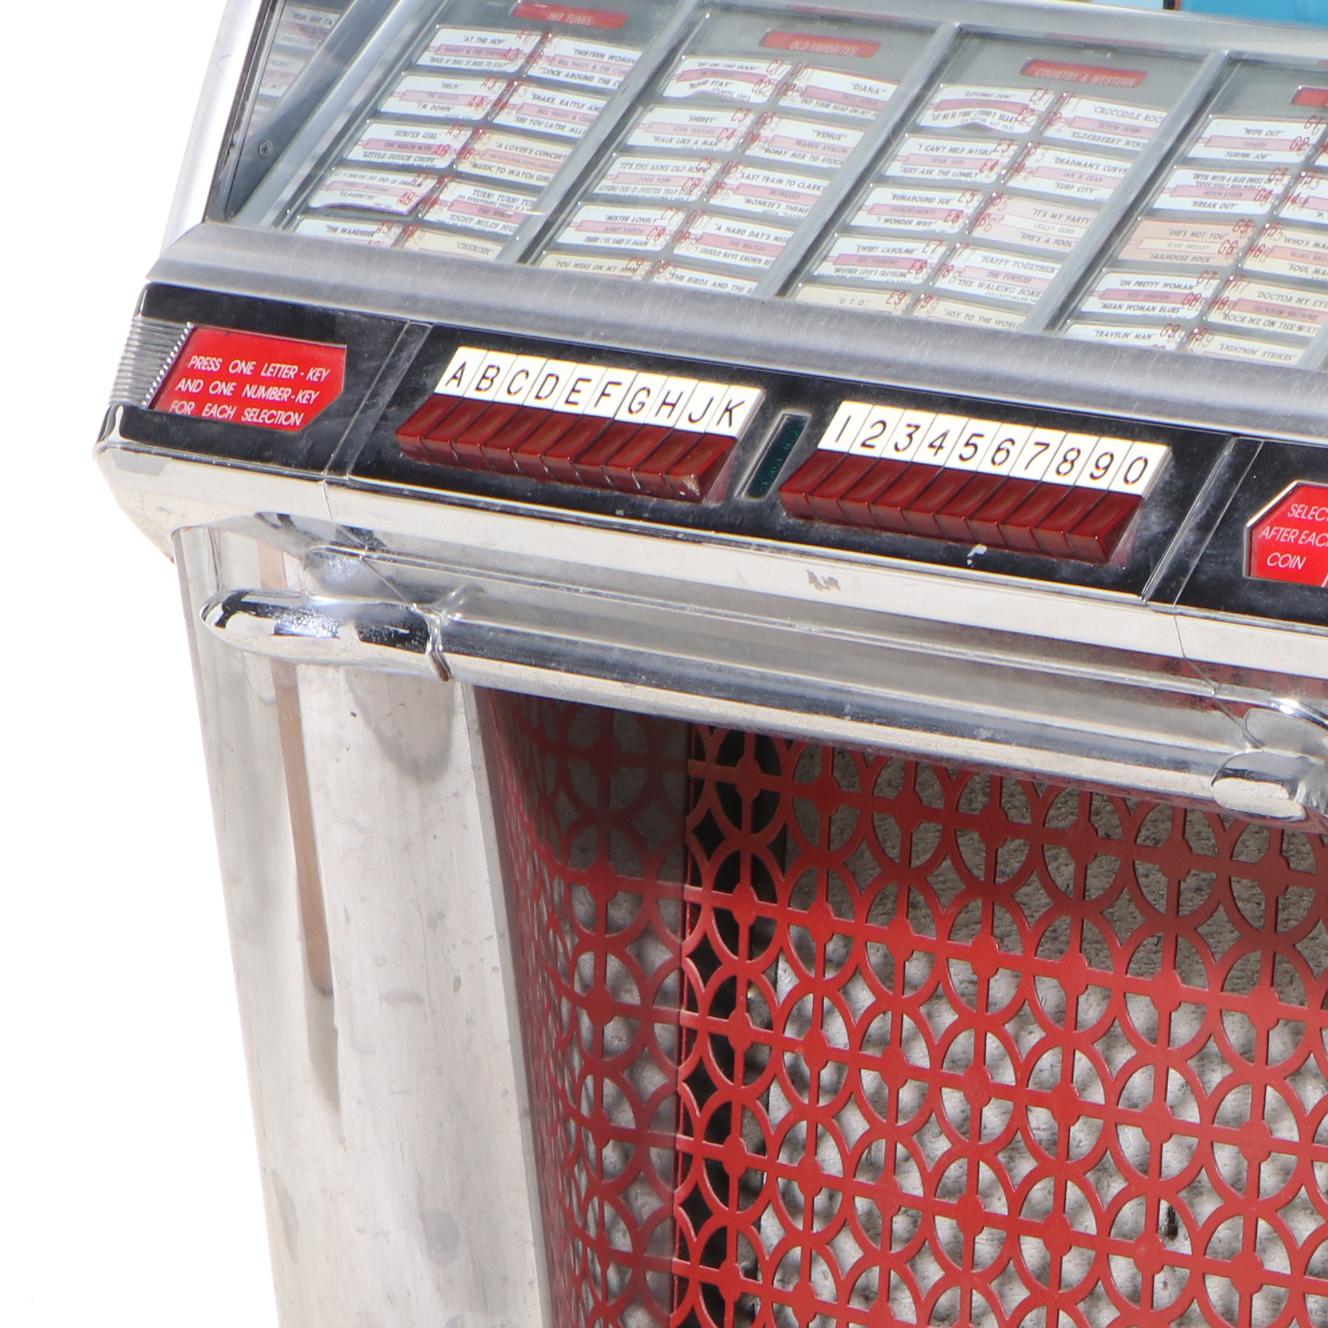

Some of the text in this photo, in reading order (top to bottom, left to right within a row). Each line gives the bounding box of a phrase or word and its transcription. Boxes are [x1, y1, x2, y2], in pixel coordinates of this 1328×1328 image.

[188, 355, 222, 373] PRESS
[228, 360, 255, 376] ONE
[260, 362, 297, 381] LETTER
[305, 366, 330, 383] KEY
[175, 377, 204, 393] AND
[208, 380, 237, 397] ONE
[445, 361, 745, 428] A B C D E F G H J K
[169, 400, 304, 427] FOR EACH SELECTION
[860, 420, 887, 449] 2
[893, 423, 921, 453] 3
[927, 428, 951, 456] 4
[958, 433, 985, 462] 5
[990, 438, 1016, 467] 6
[1024, 441, 1051, 471] 7
[1055, 447, 1082, 476] 8
[1089, 451, 1115, 481] 9
[1122, 456, 1149, 486] 0
[1258, 526, 1299, 545] AFTER
[1266, 552, 1307, 571] COIN
